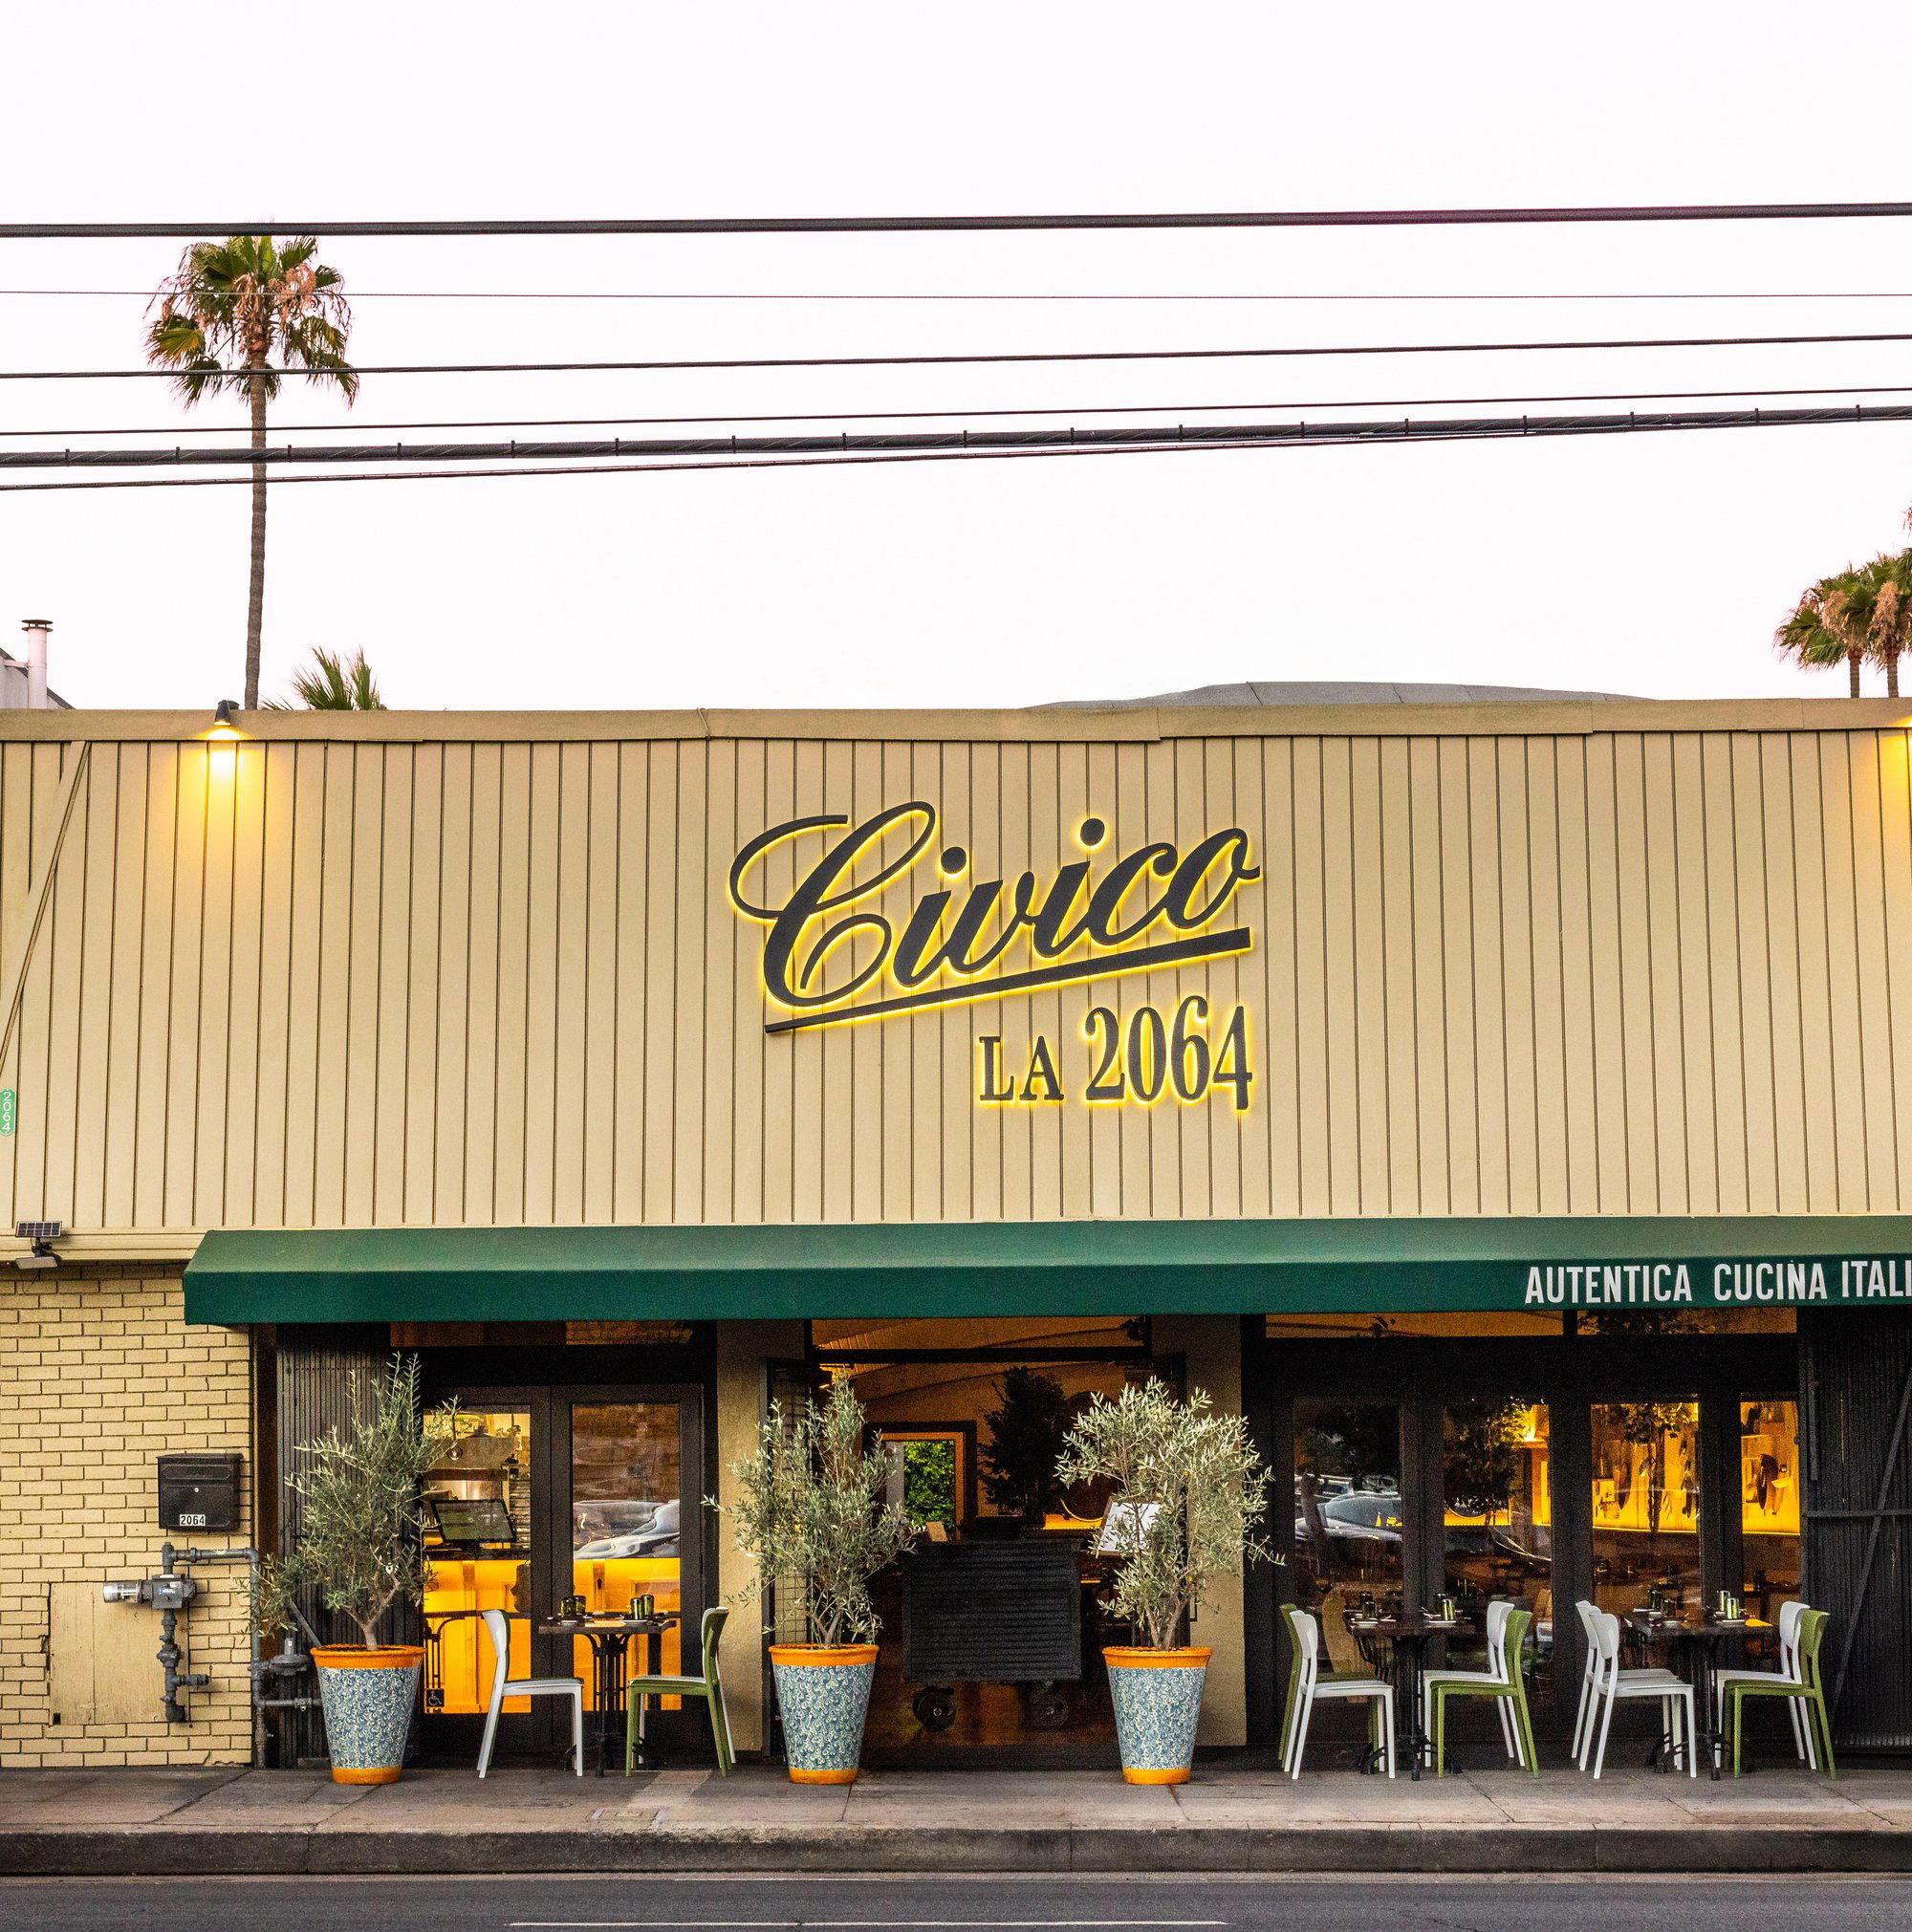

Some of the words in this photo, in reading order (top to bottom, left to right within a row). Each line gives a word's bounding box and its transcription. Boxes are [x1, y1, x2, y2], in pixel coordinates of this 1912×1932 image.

[729, 801, 1260, 1007] Civico
[978, 1036, 1064, 1101] LA
[1085, 995, 1252, 1110] 2064
[3, 1091, 11, 1132] 2064
[1525, 1265, 1692, 1303] AUTENTICA
[1713, 1262, 1828, 1301] CUCINA
[1841, 1260, 1912, 1297] ITALI
[180, 1515, 205, 1526] 2064
